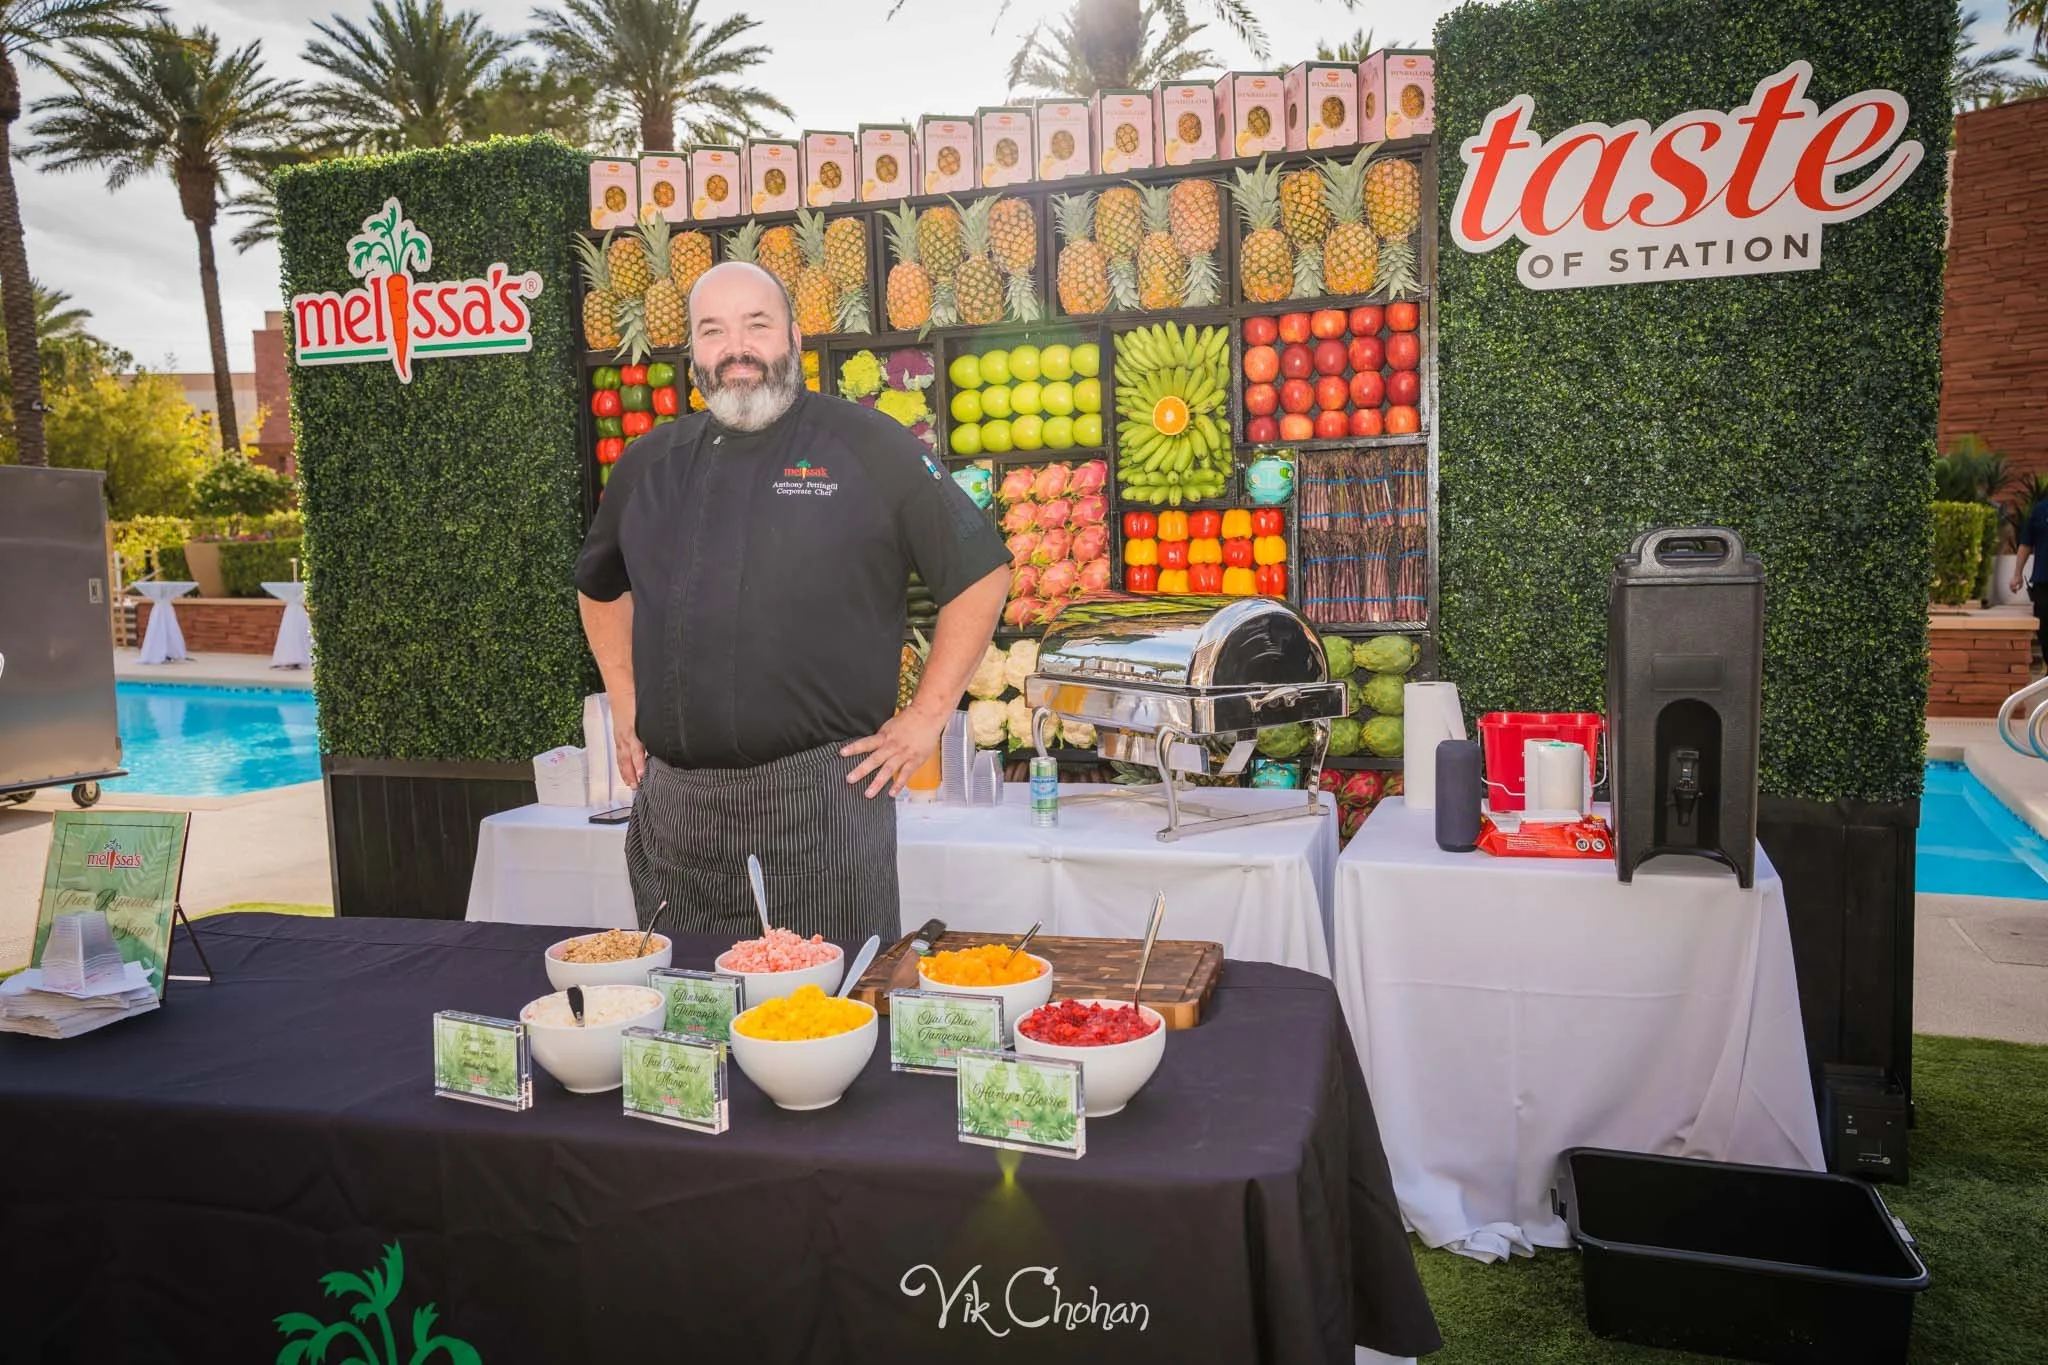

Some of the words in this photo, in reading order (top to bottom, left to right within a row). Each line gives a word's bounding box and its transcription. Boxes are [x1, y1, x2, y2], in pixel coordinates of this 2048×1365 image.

[1461, 72, 1910, 242] taste
[1527, 250, 1584, 280] OF
[1608, 232, 1810, 274] STATION
[772, 481, 803, 489] Anthony
[776, 488, 812, 496] Corporate
[814, 488, 832, 496] Chef
[87, 852, 142, 872] melissa's
[945, 1013, 977, 1026] Pixie
